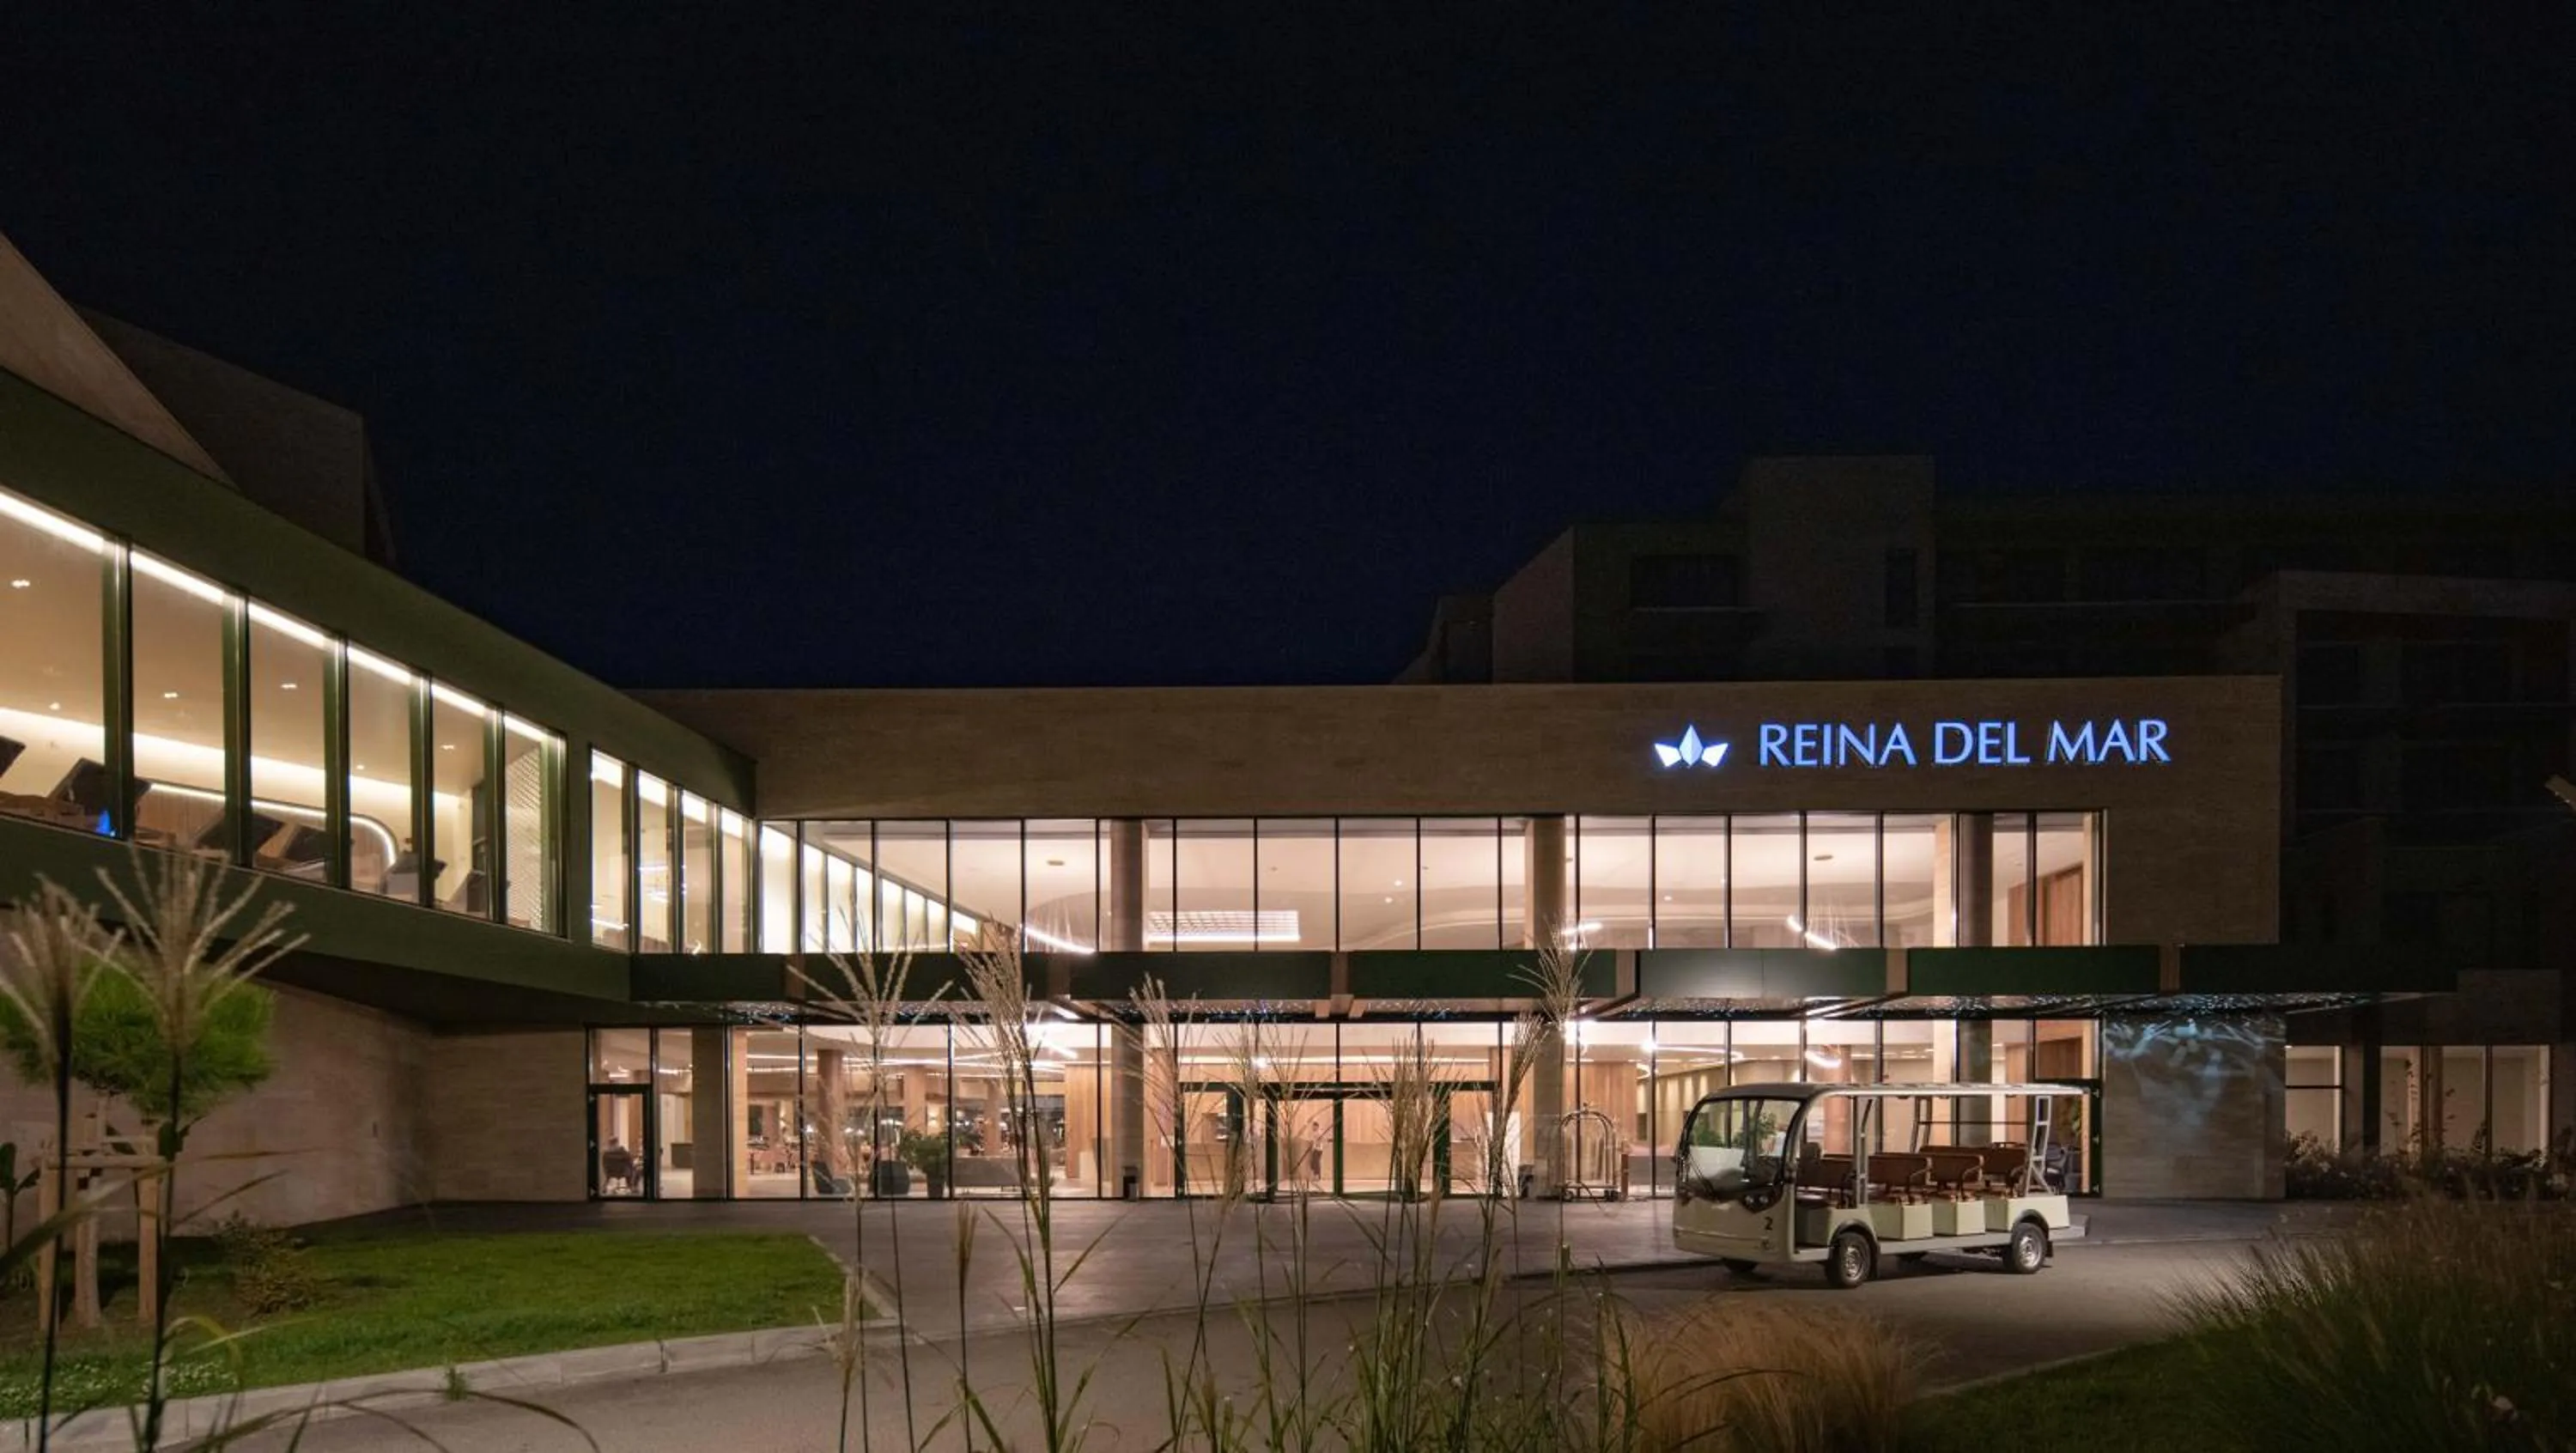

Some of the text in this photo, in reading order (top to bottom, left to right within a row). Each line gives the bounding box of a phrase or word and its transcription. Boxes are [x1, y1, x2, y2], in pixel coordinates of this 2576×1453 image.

[1759, 719, 2172, 766] REINA DEL MAR
[1765, 1216, 1773, 1231] 2
